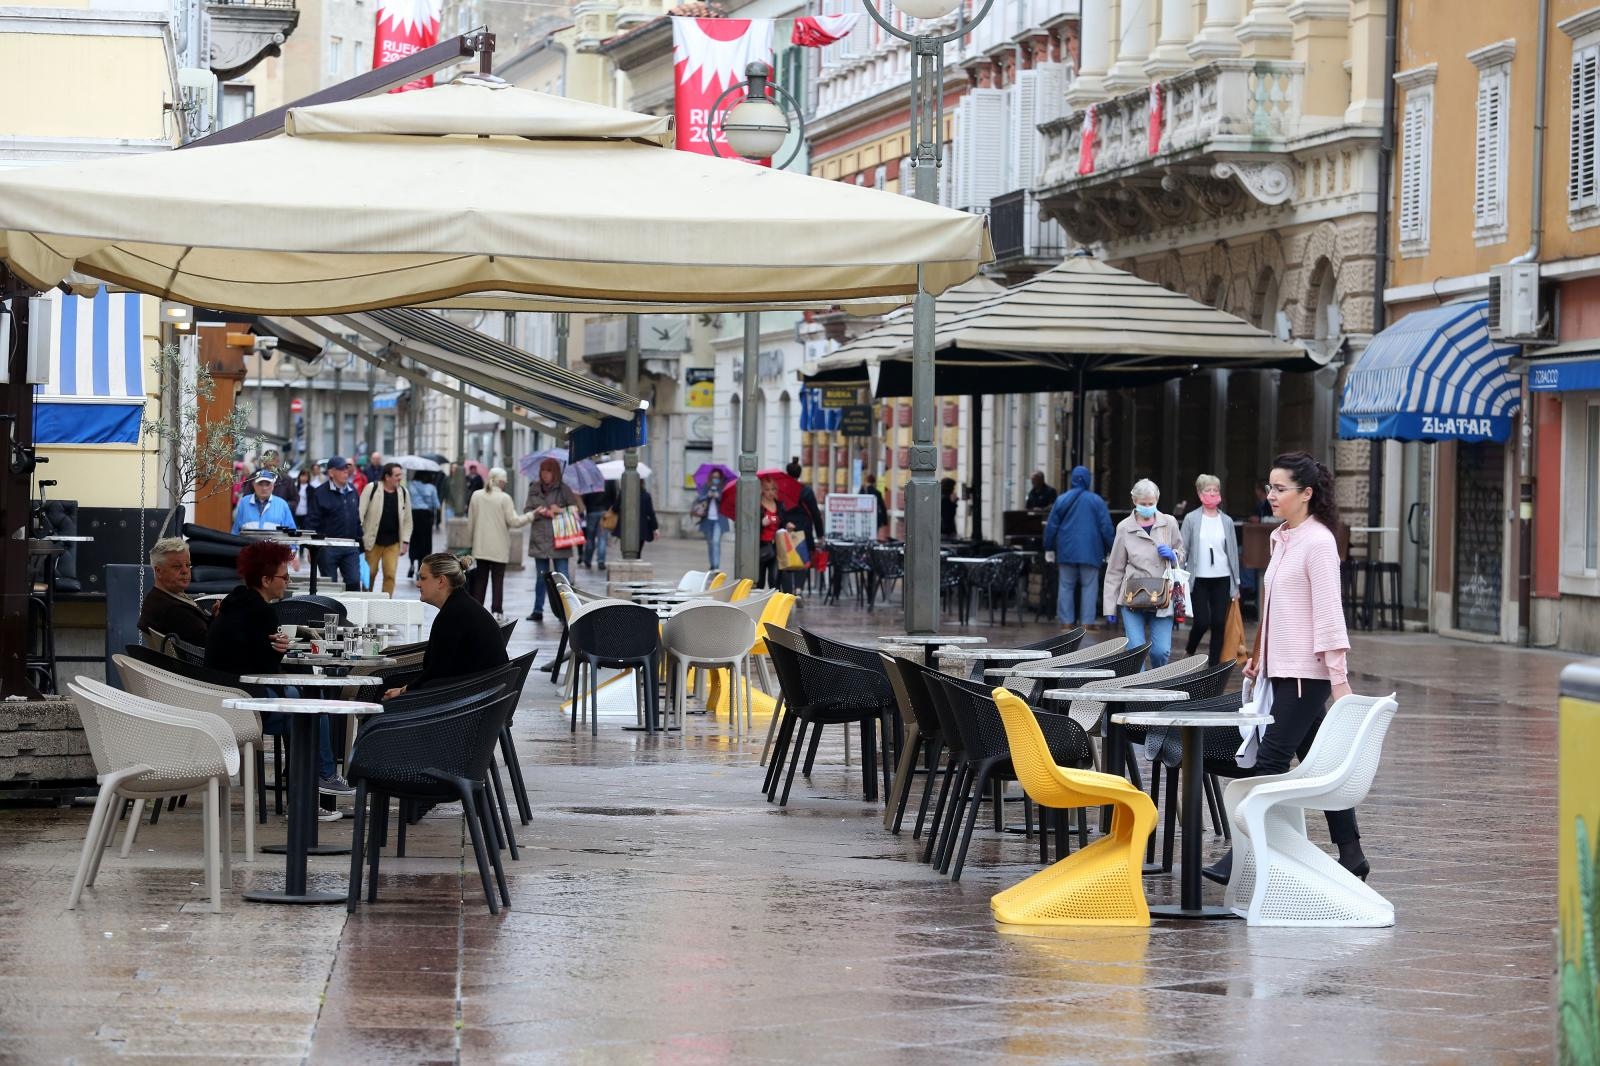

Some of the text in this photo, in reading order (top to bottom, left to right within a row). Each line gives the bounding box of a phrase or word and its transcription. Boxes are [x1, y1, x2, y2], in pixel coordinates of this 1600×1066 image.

[383, 40, 425, 55] RIJEK
[382, 51, 408, 62] 20
[689, 127, 728, 142] 202
[1422, 417, 1492, 437] ZLATAR
